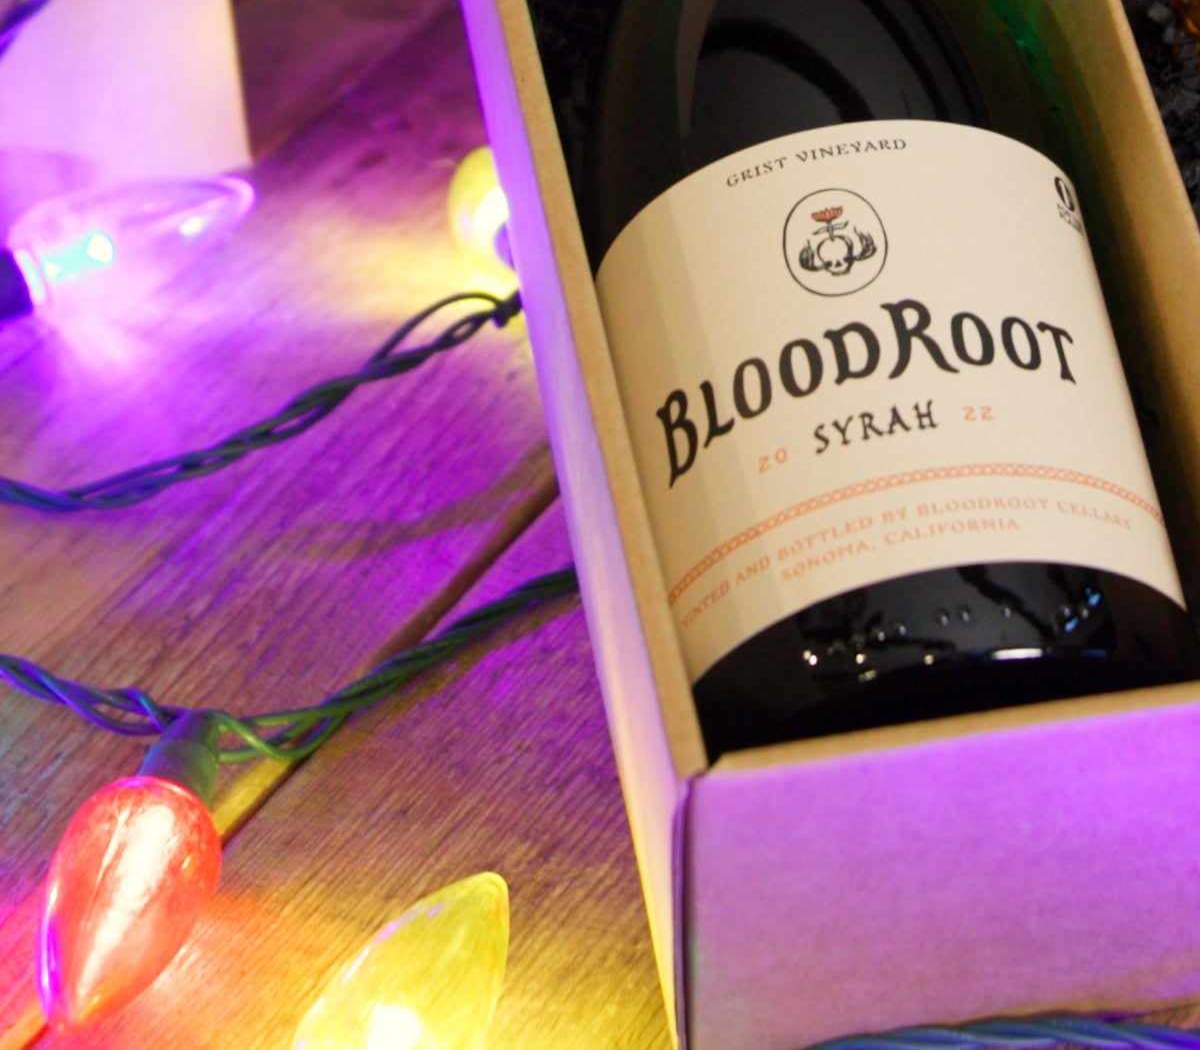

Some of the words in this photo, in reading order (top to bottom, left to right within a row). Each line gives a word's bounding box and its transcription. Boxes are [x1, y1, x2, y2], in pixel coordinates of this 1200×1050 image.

[726, 157, 787, 187] GRIST
[795, 137, 907, 163] VINEYARD
[655, 298, 1077, 489] BLOODROOT
[757, 447, 789, 474] 20
[812, 398, 939, 456] SYRAH
[962, 404, 994, 422] 22
[735, 555, 771, 585] AND
[777, 515, 873, 561] BOTTLED
[881, 507, 908, 524] BY
[916, 496, 1050, 517] BLOODROOT
[1056, 501, 1132, 531] CELLARS
[884, 517, 1021, 545] CALIFORNIA
